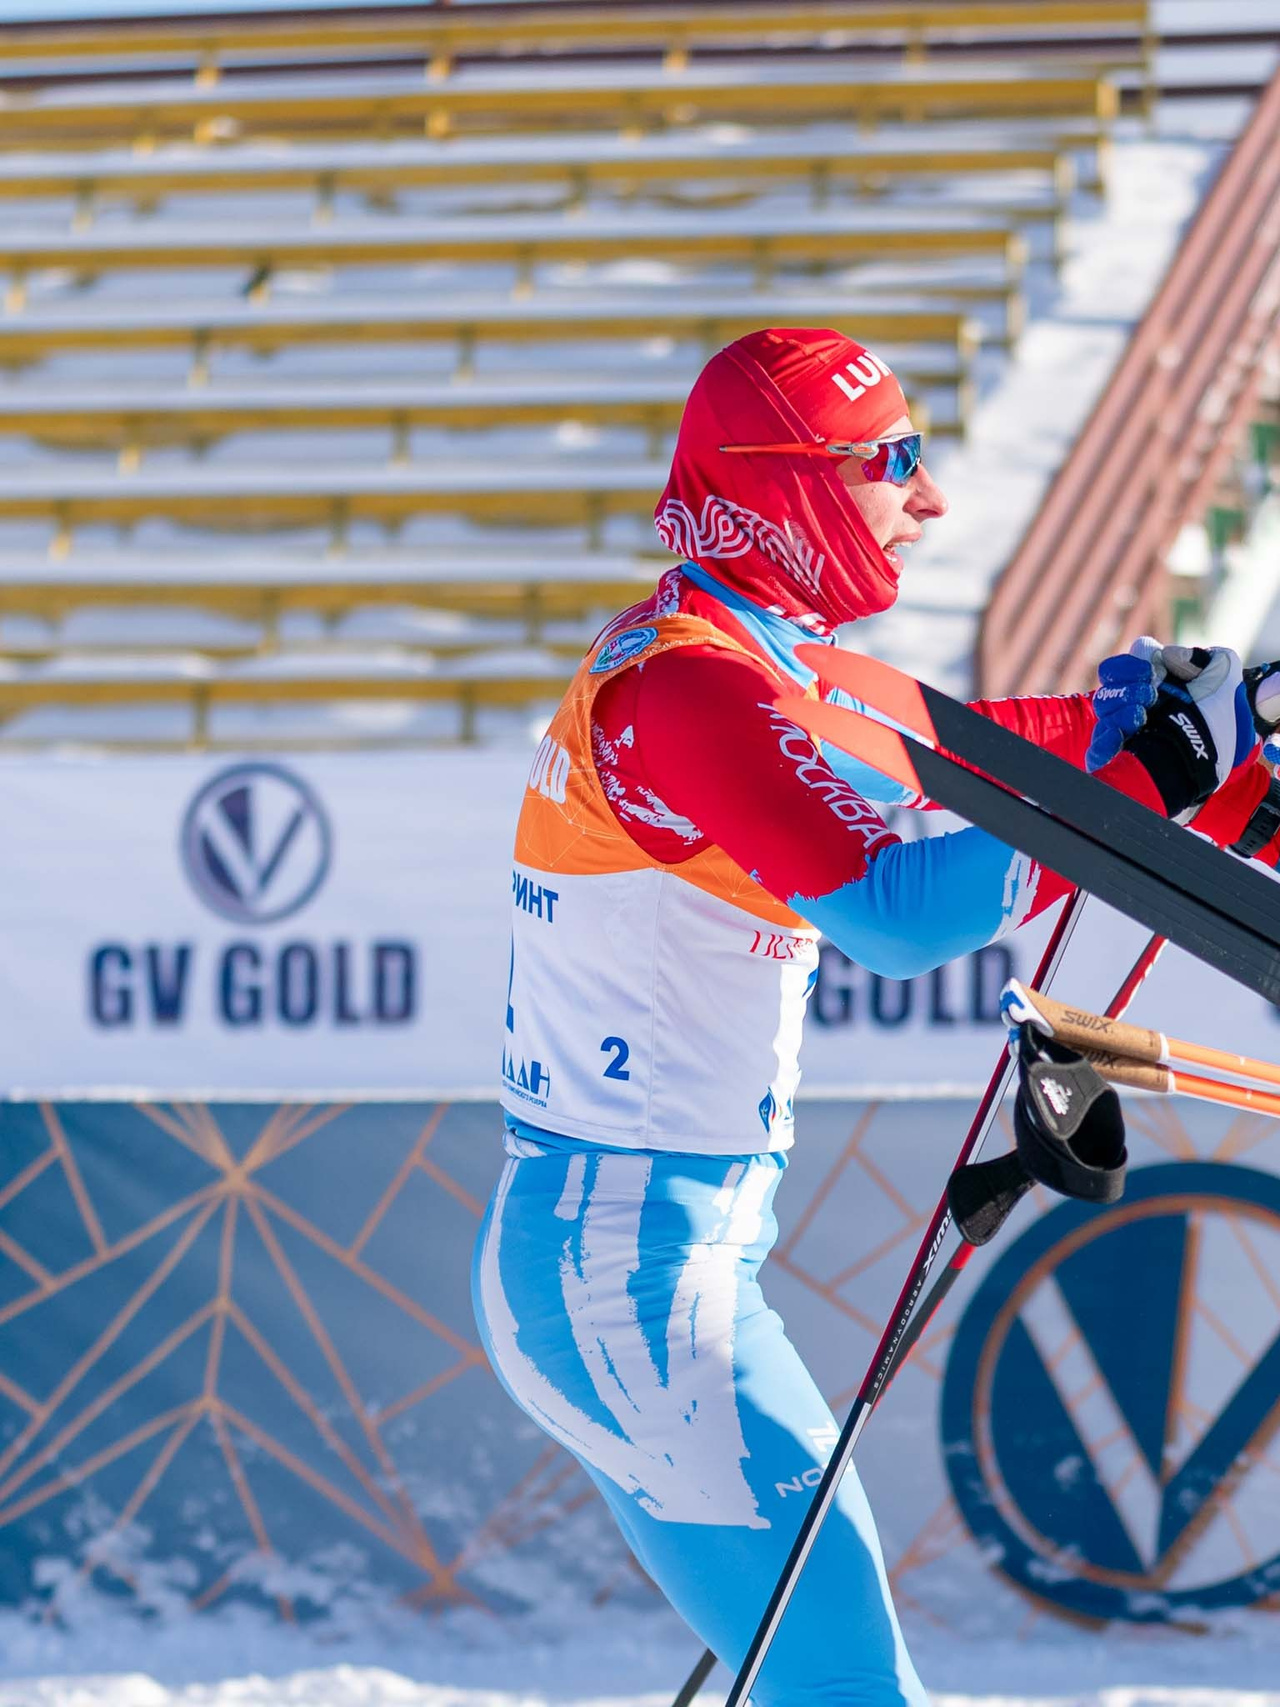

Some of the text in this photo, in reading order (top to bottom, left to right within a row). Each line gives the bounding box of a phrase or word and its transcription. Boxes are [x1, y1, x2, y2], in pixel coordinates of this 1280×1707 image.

[89, 940, 194, 1028] GV
[218, 940, 419, 1028] GOLD
[600, 1036, 630, 1081] 2
[873, 1279, 922, 1389] AERODYNAMICS
